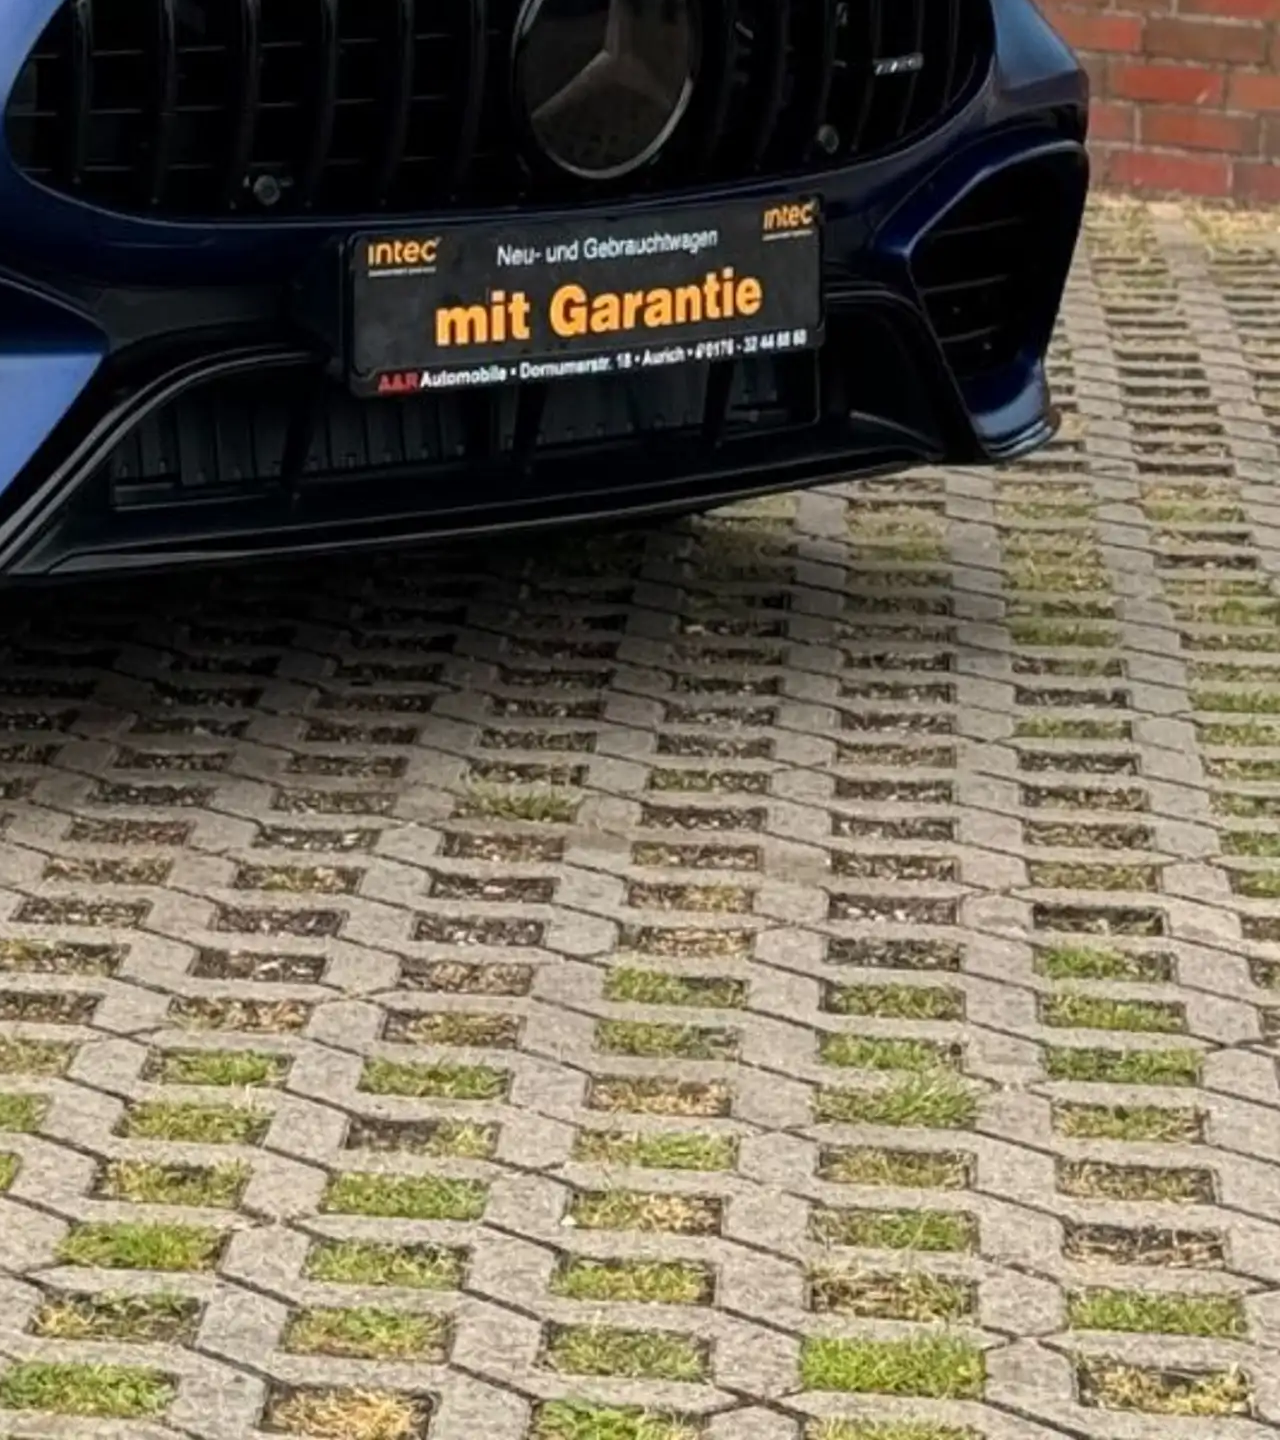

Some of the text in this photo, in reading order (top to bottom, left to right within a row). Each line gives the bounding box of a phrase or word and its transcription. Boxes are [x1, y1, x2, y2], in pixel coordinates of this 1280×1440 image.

[762, 202, 815, 231] intec
[367, 238, 438, 267] intec
[496, 229, 718, 267] Neu- und Gebrauchtwagen
[435, 265, 763, 347] mit Garantie
